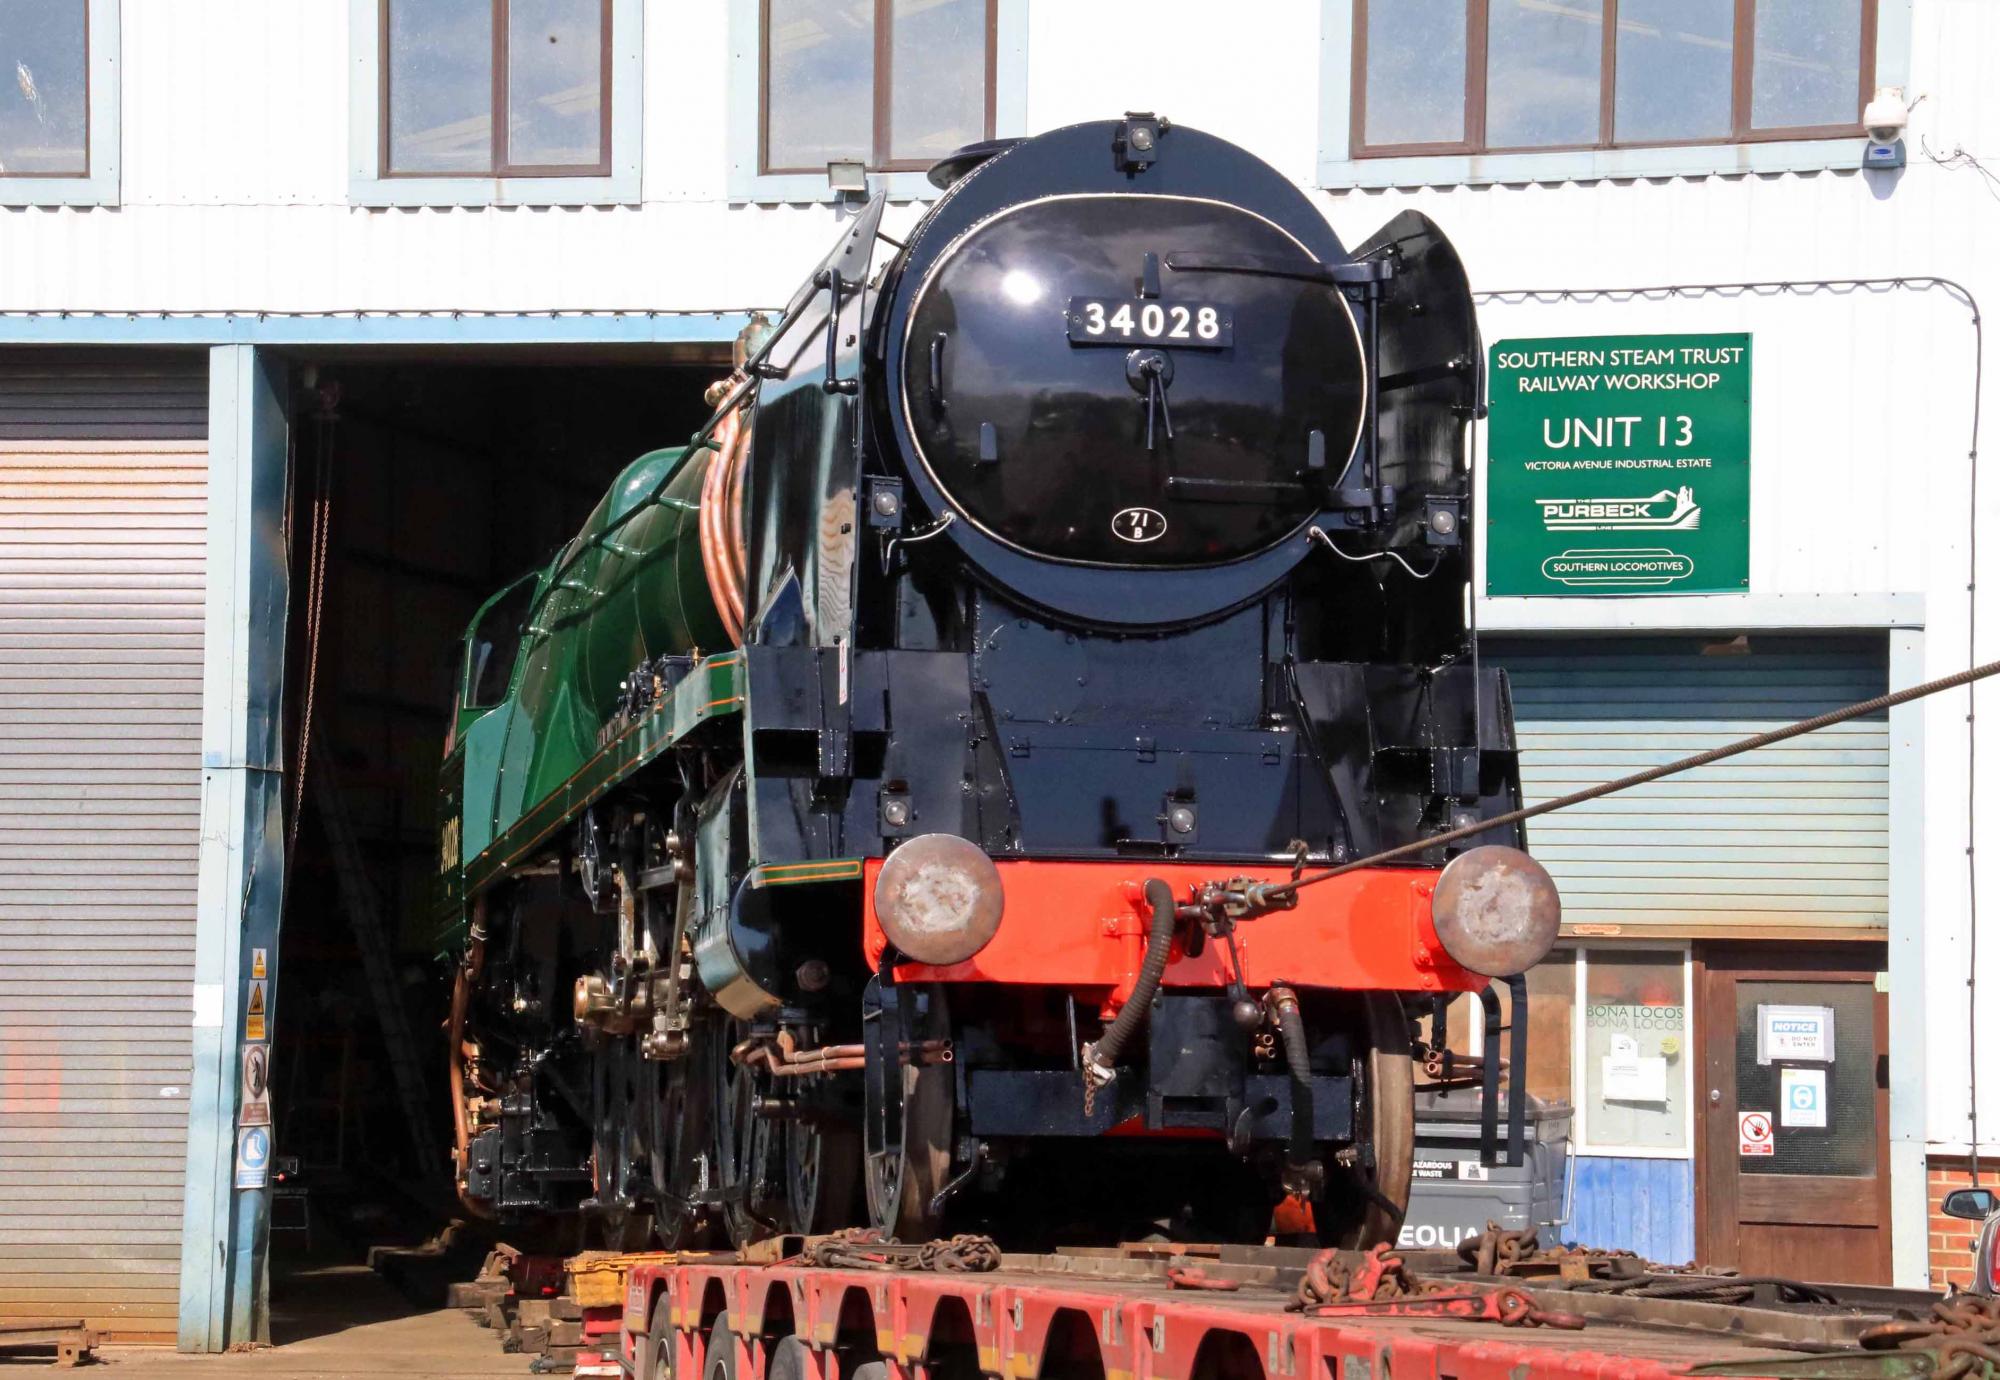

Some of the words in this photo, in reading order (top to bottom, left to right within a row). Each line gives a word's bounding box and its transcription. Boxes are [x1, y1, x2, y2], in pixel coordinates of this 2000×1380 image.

[1085, 302, 1219, 339] 34028
[1498, 351, 1604, 369] SOUTHERN
[1610, 349, 1674, 366] STEAM
[1680, 348, 1744, 364] TRUST
[1519, 375, 1600, 392] RAILWAY
[1604, 373, 1720, 390] WORKSHOP
[1543, 416, 1642, 448] UNIT
[1659, 415, 1693, 446] 13
[1524, 461, 1571, 471] VICTORIA
[1573, 460, 1612, 470] AVENUE
[1615, 459, 1674, 469] INDUSTRIAL
[1676, 458, 1712, 468] ESTATE
[1543, 503, 1651, 518] PURBECK
[1130, 512, 1148, 527] 71
[1134, 527, 1143, 539] B
[1553, 562, 1608, 572] SOUTHERN
[1610, 561, 1683, 572] LOCOMOTIVES
[1586, 1005, 1628, 1018] BONA
[1633, 1006, 1684, 1019] LOCOS
[1774, 1021, 1816, 1032] NOTICE
[1412, 1161, 1453, 1170] AZARDOUS
[1418, 1170, 1443, 1178] WASTE
[1397, 1225, 1479, 1248] EOLIA
